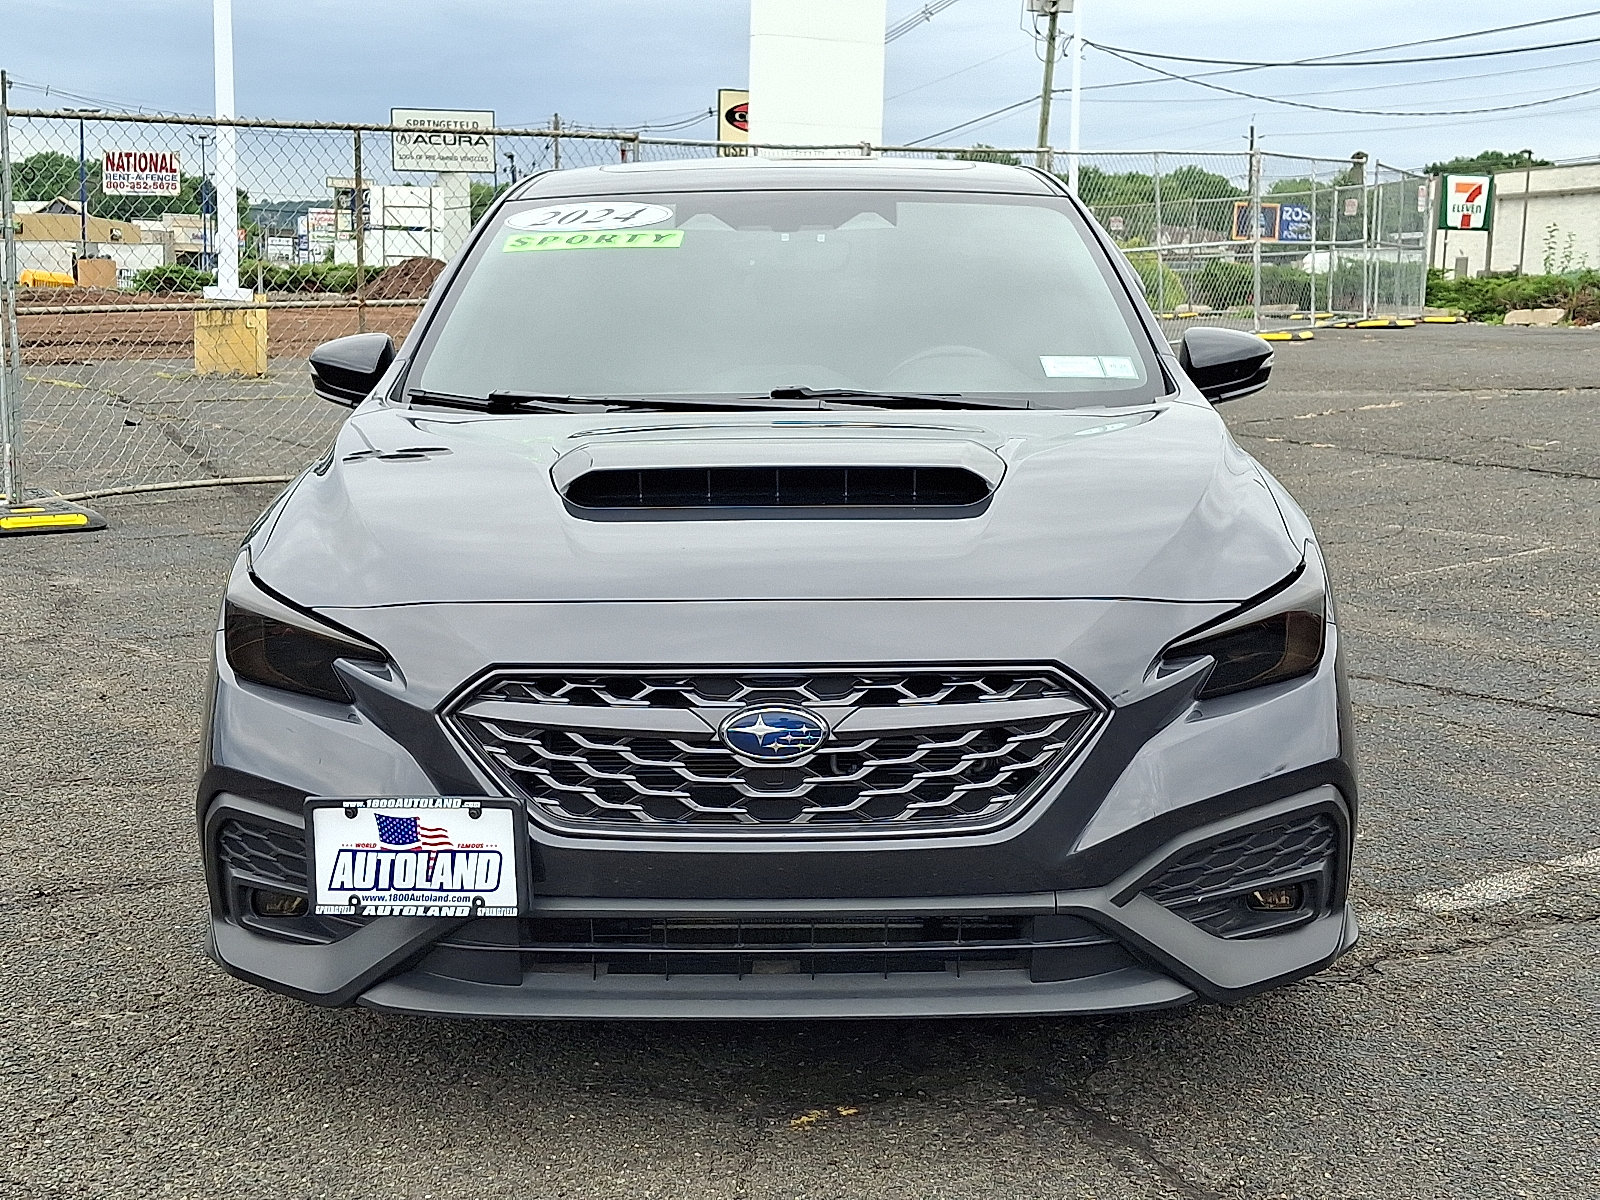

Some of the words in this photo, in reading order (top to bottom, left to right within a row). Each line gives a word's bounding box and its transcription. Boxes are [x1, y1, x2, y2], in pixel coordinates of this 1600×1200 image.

[413, 134, 490, 147] ACURA
[105, 151, 177, 173] NATIONAL
[105, 173, 178, 182] RENT-A-FENCE
[106, 181, 177, 190] 800-352-5675
[527, 207, 649, 227] 2024
[509, 233, 678, 247] SPORTY
[328, 849, 503, 892] AUTOLAND
[361, 893, 471, 903] www.1800Autoland.com
[315, 905, 356, 915] SPRINGFIELD
[362, 905, 471, 917] AUTOLAND
[476, 907, 518, 917] SPRINGFIELD
